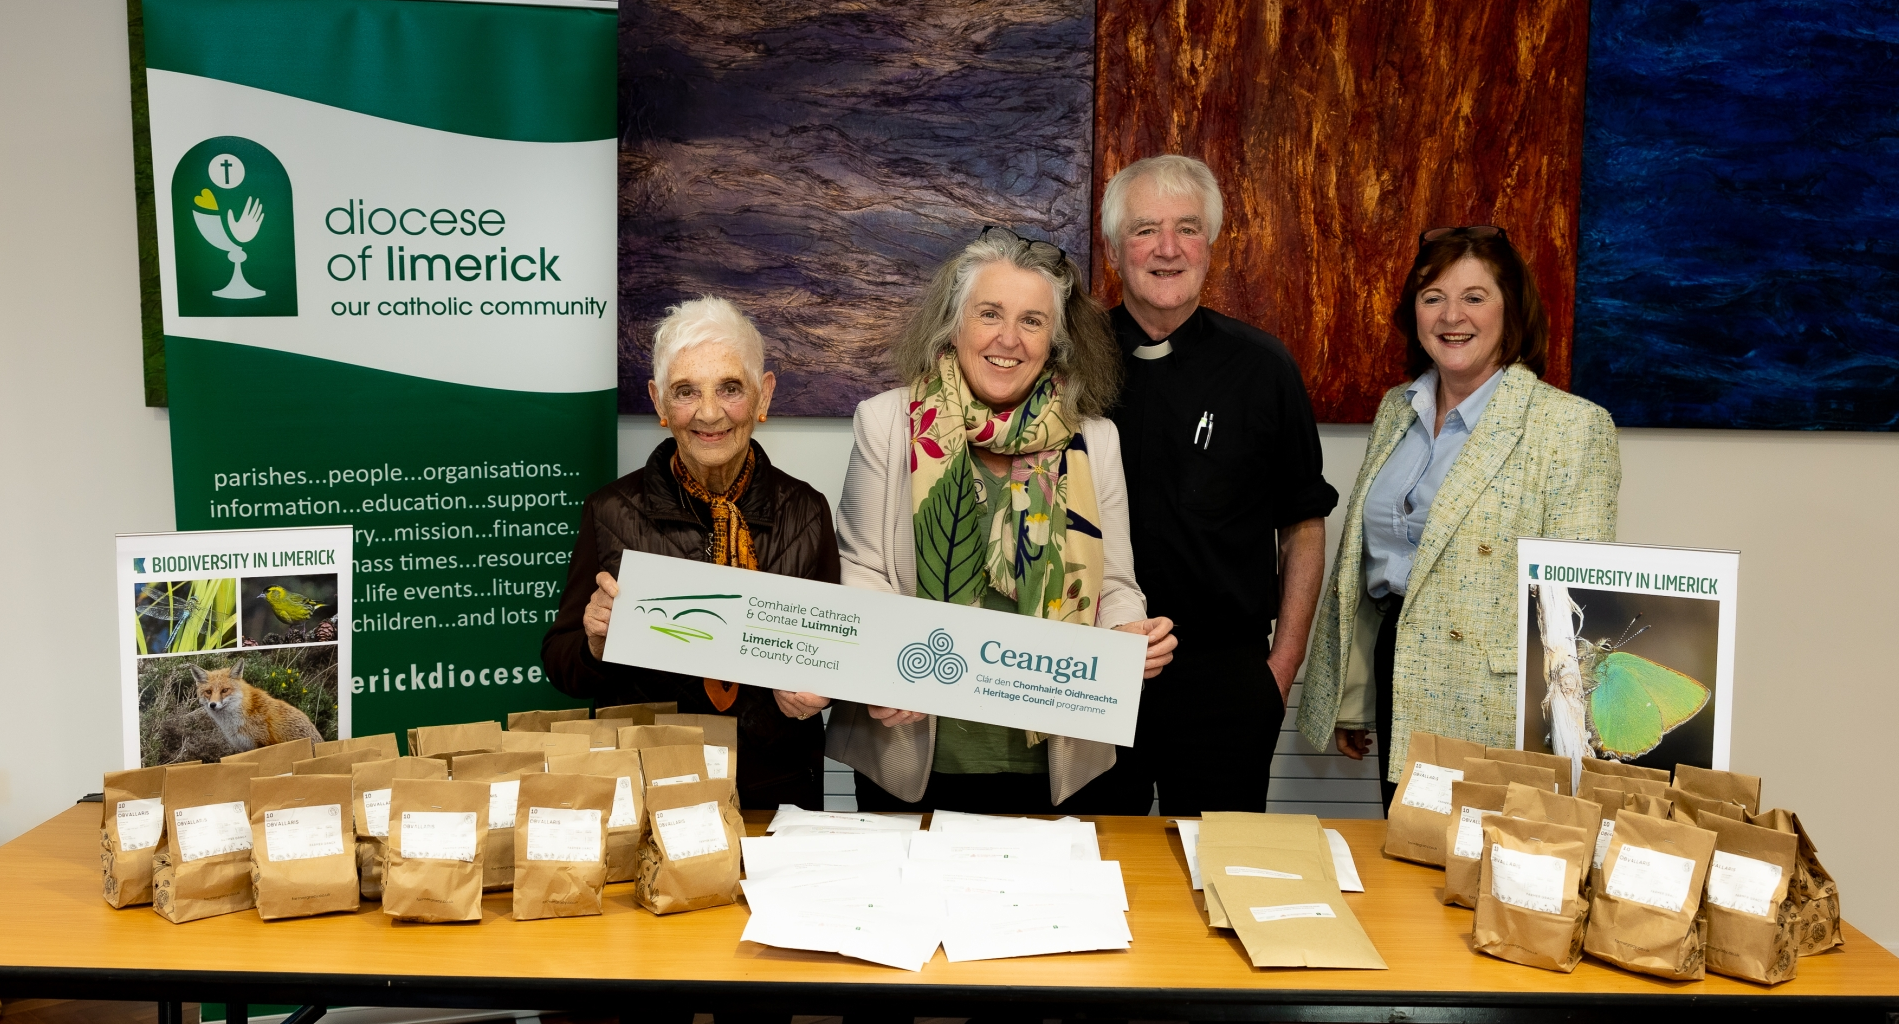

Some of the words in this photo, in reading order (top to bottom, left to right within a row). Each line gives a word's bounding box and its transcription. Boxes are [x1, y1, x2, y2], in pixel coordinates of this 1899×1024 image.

[325, 198, 506, 236] diocese
[327, 245, 372, 281] of
[387, 245, 562, 282] limerick
[331, 301, 370, 316] our
[377, 297, 473, 316] catholic
[480, 296, 607, 319] community
[152, 552, 250, 574] BIODIVERSITY
[253, 551, 268, 569] IN
[272, 549, 336, 568] LIMERICK
[1544, 564, 1633, 588] BIODIVERSITY
[1636, 571, 1650, 589] IN
[1654, 573, 1718, 595] LIMERICK
[501, 606, 538, 625] lots
[746, 609, 755, 619] &
[757, 611, 798, 626] Contae
[801, 618, 858, 637] Luimnigh
[748, 596, 807, 615] Comhairle
[810, 606, 861, 624] Cathrach
[742, 632, 794, 650] Limerick
[796, 641, 819, 655] City
[739, 645, 748, 655] &
[751, 647, 793, 664] County
[795, 654, 840, 671] Council
[980, 640, 1099, 684] Ceangal
[351, 662, 550, 694] erickdiocese
[976, 673, 993, 684] Clár
[994, 677, 1011, 687] den
[1012, 680, 1063, 696] Chomhairle
[1064, 688, 1118, 705] Oidhreachta
[973, 686, 981, 695] A
[982, 687, 1021, 702] Heritage
[1022, 694, 1055, 707] Council
[1055, 699, 1106, 715] programme
